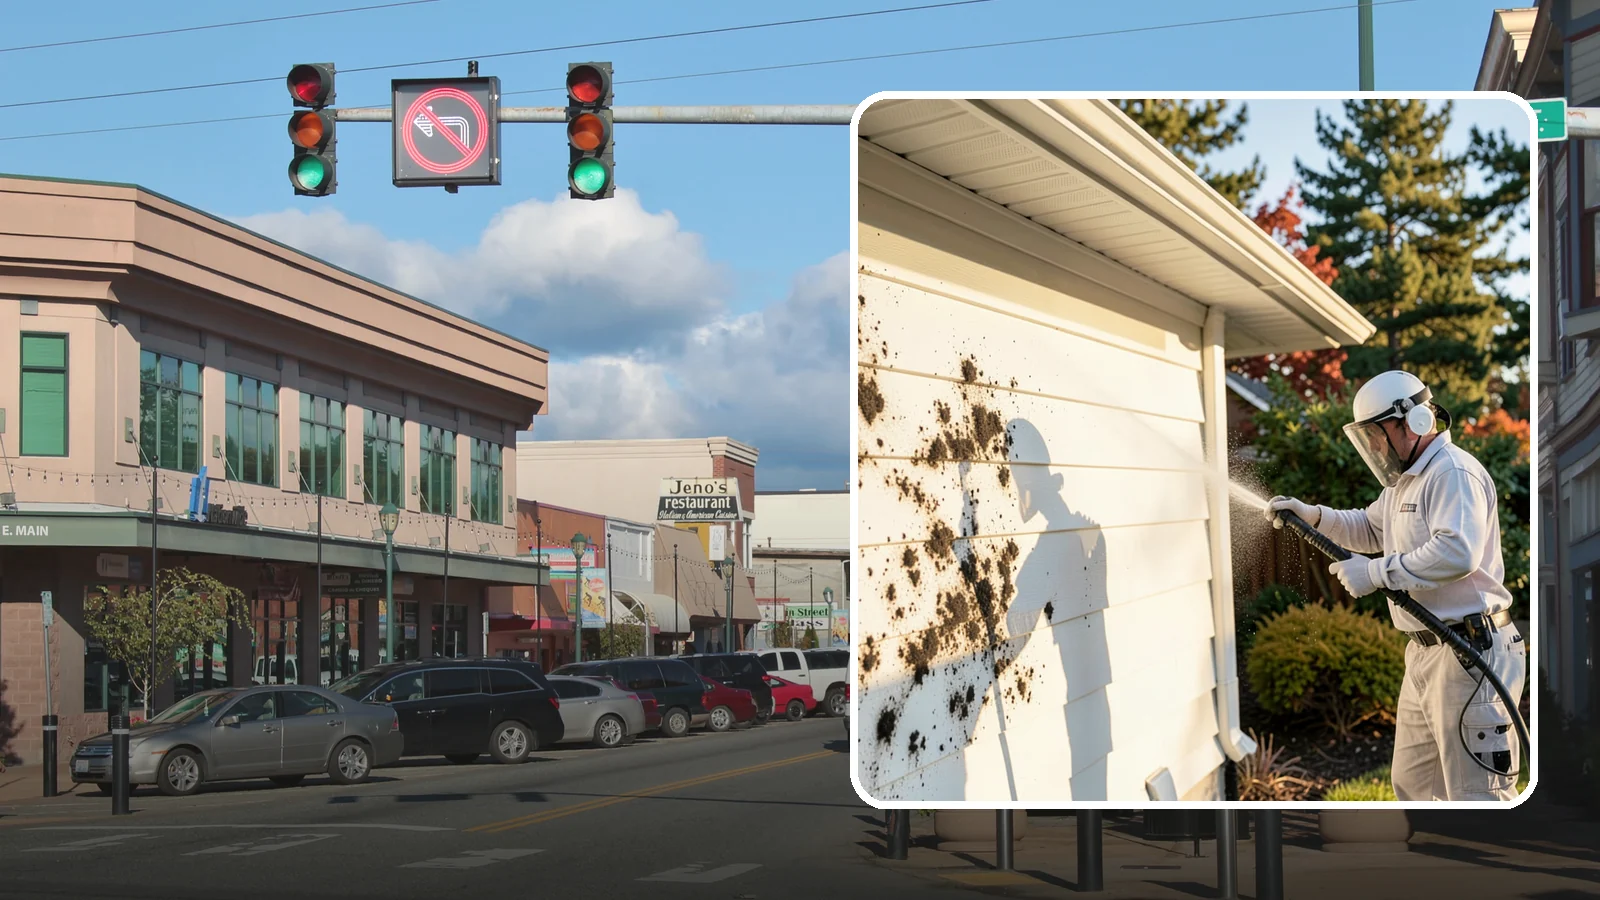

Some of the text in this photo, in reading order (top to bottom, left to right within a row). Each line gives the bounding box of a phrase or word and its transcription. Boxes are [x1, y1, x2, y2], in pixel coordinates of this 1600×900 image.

[670, 480, 727, 494] Jeno's
[665, 496, 730, 509] restaurant
[658, 509, 681, 520] Italian
[685, 509, 715, 519] American
[714, 509, 738, 519] Cuisine
[2, 525, 49, 536] E. MAIN
[797, 607, 828, 617] Street
[790, 619, 824, 627] lass
